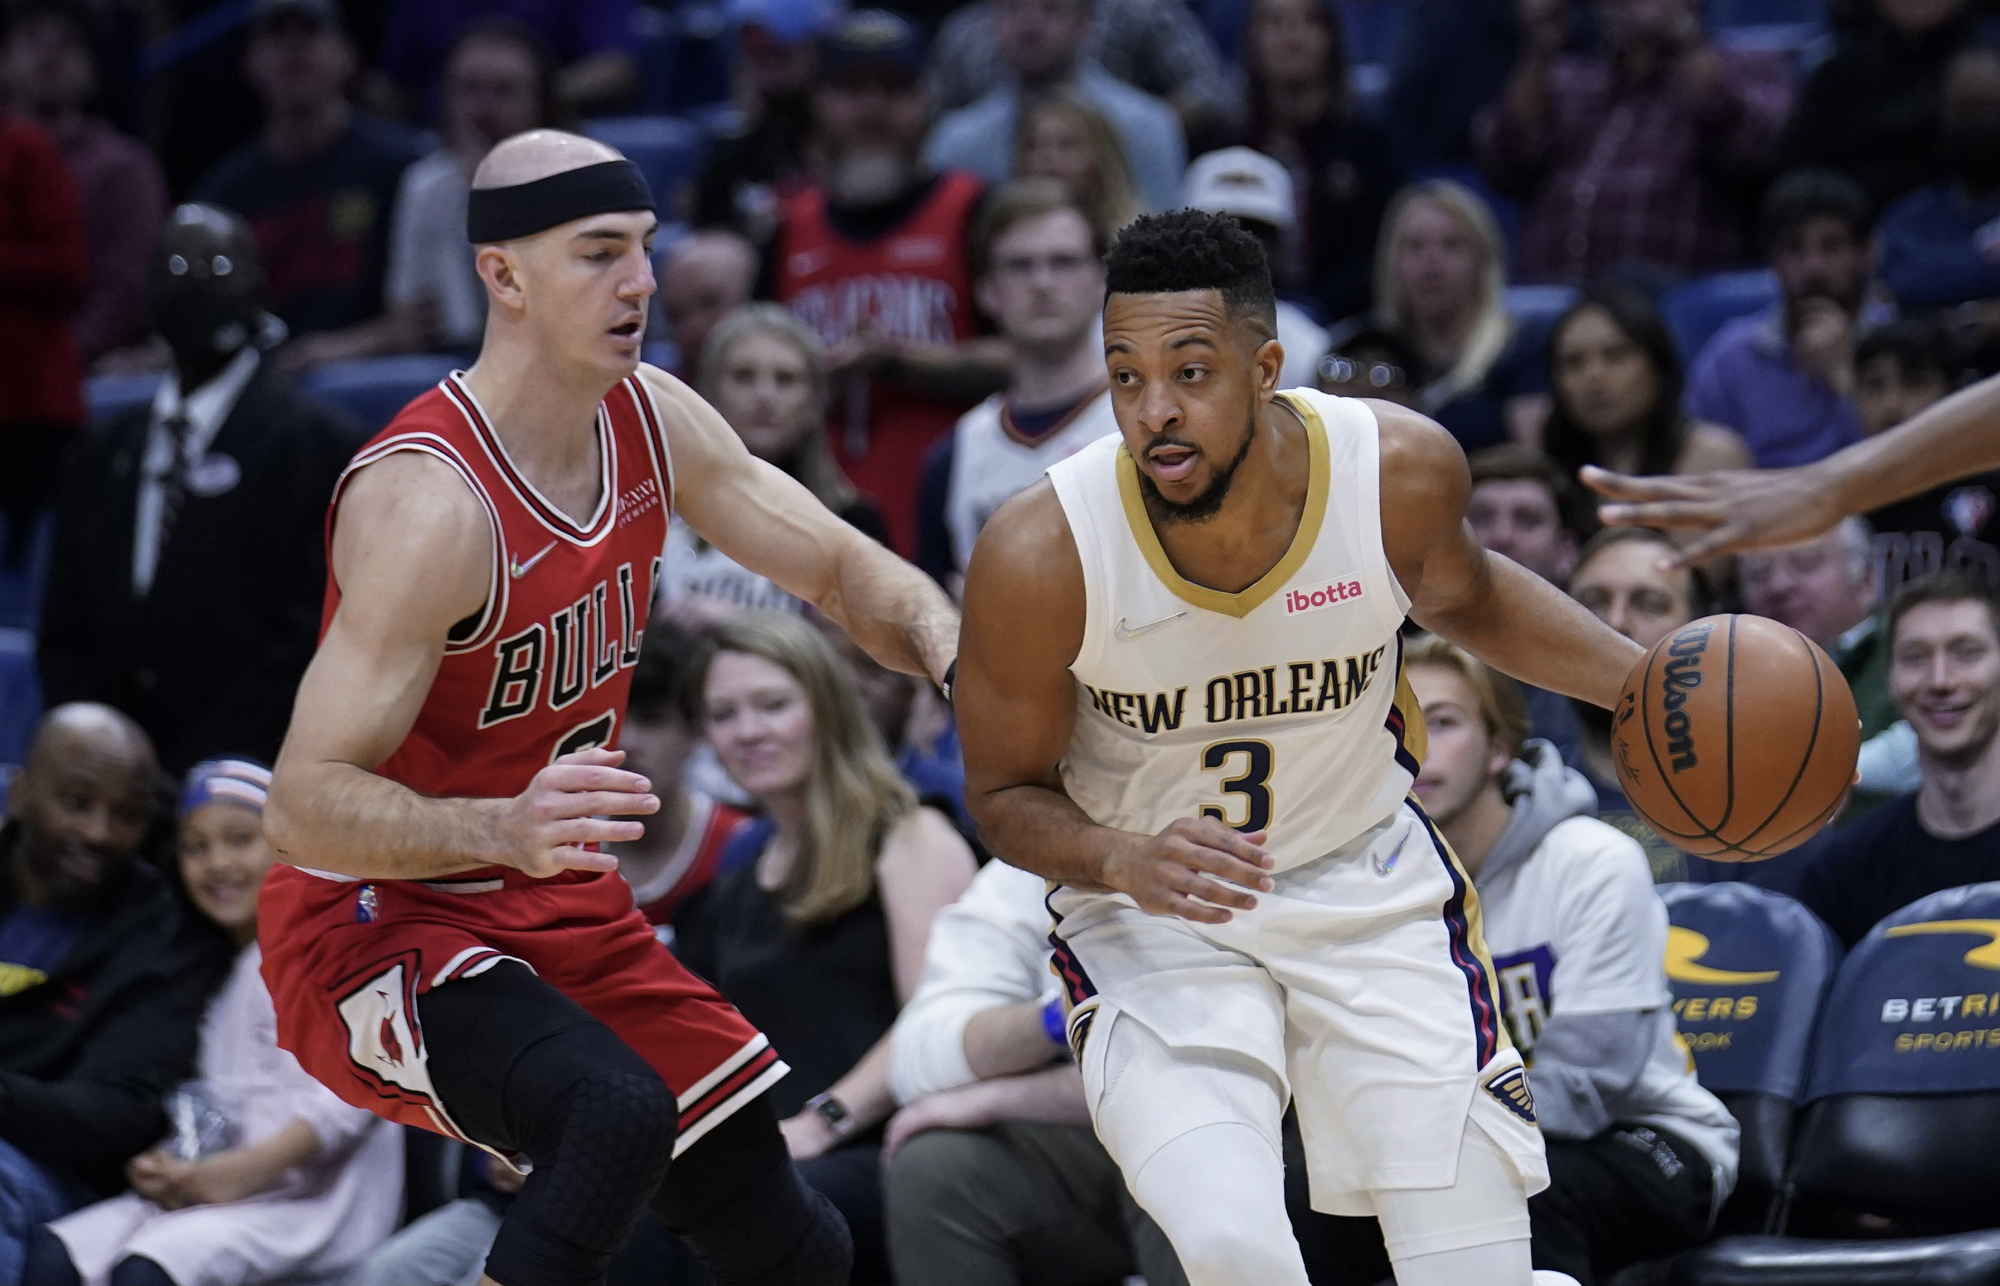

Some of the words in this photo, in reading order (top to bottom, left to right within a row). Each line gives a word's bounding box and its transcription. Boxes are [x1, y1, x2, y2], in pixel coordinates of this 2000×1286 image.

[1286, 581, 1362, 613] ibotta
[1084, 684, 1188, 734] NEW
[1204, 644, 1386, 723] ORLEANS
[1663, 623, 1715, 774] Wilson
[1200, 738, 1275, 833] 3
[1881, 992, 2000, 1022] BETRI
